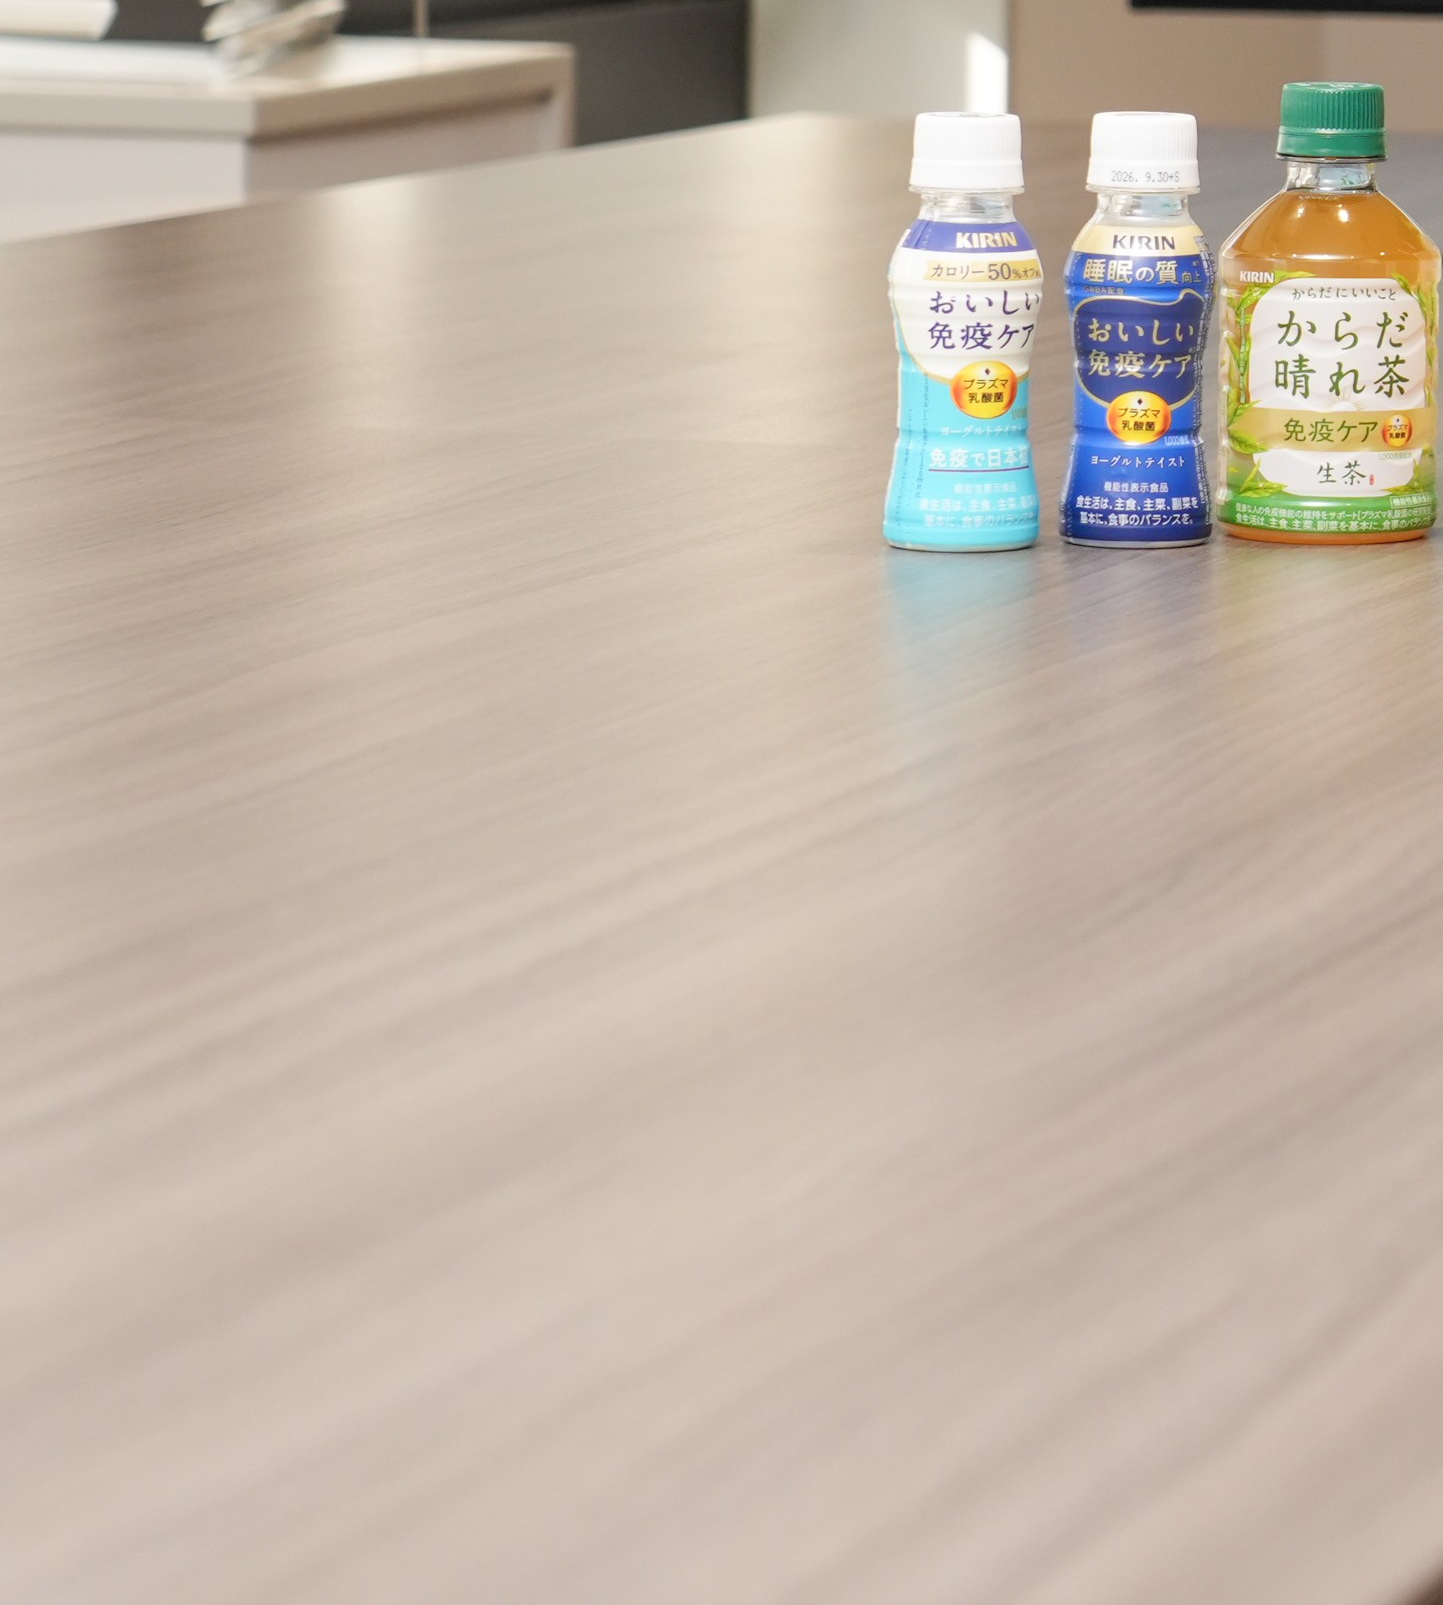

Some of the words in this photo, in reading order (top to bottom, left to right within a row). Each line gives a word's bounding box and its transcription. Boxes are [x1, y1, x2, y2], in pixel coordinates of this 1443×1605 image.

[1111, 170, 1138, 183] 2026.
[955, 232, 1018, 249] KIRIN
[1112, 234, 1176, 251] KIRIN
[1083, 258, 1202, 285] 睡眠の質向上
[1239, 270, 1275, 284] KIRIN
[929, 290, 1040, 315] おいしい
[1292, 287, 1398, 301] からだにいいこと
[928, 321, 1035, 350] 免疫ケア
[1088, 318, 1193, 345] おいしい
[1277, 310, 1409, 350] からだ
[1088, 349, 1191, 378] 免疫ケア
[963, 378, 1009, 390] プラズマ
[1274, 353, 1410, 399] 晴れ茶
[968, 392, 1005, 404] 乳酸菌
[1118, 407, 1161, 419] プラズマ
[1122, 420, 1156, 432] 乳酸菌
[1284, 417, 1378, 443] 免疫ケア
[1091, 454, 1185, 468] ヨーグルトテイスト
[1317, 460, 1367, 486] 生茶
[1104, 481, 1169, 493] 機能性表示食品
